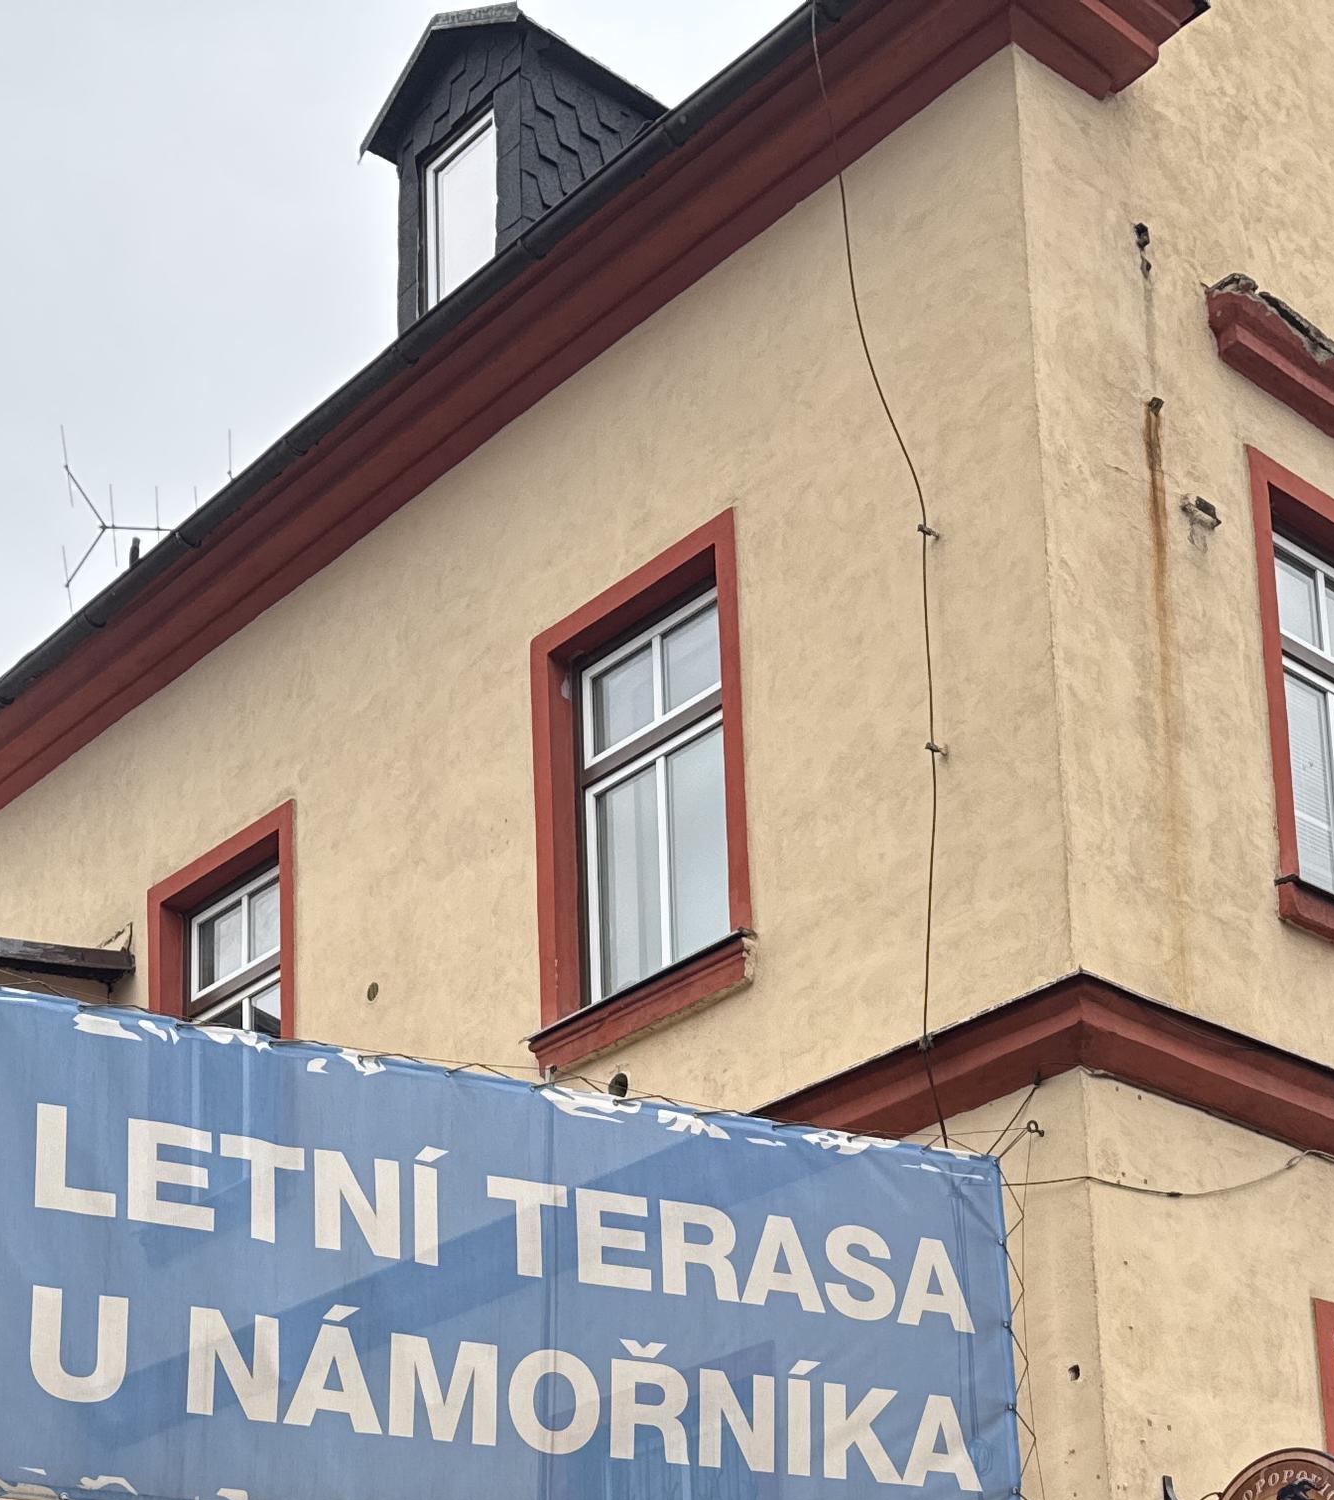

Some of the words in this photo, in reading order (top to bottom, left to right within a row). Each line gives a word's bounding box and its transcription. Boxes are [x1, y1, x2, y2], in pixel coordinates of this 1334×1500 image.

[34, 1103, 448, 1266] LETNÍ
[486, 1175, 975, 1334] TERASA
[29, 1285, 129, 1403] U
[186, 1304, 983, 1492] NÁMOŘNÍKA
